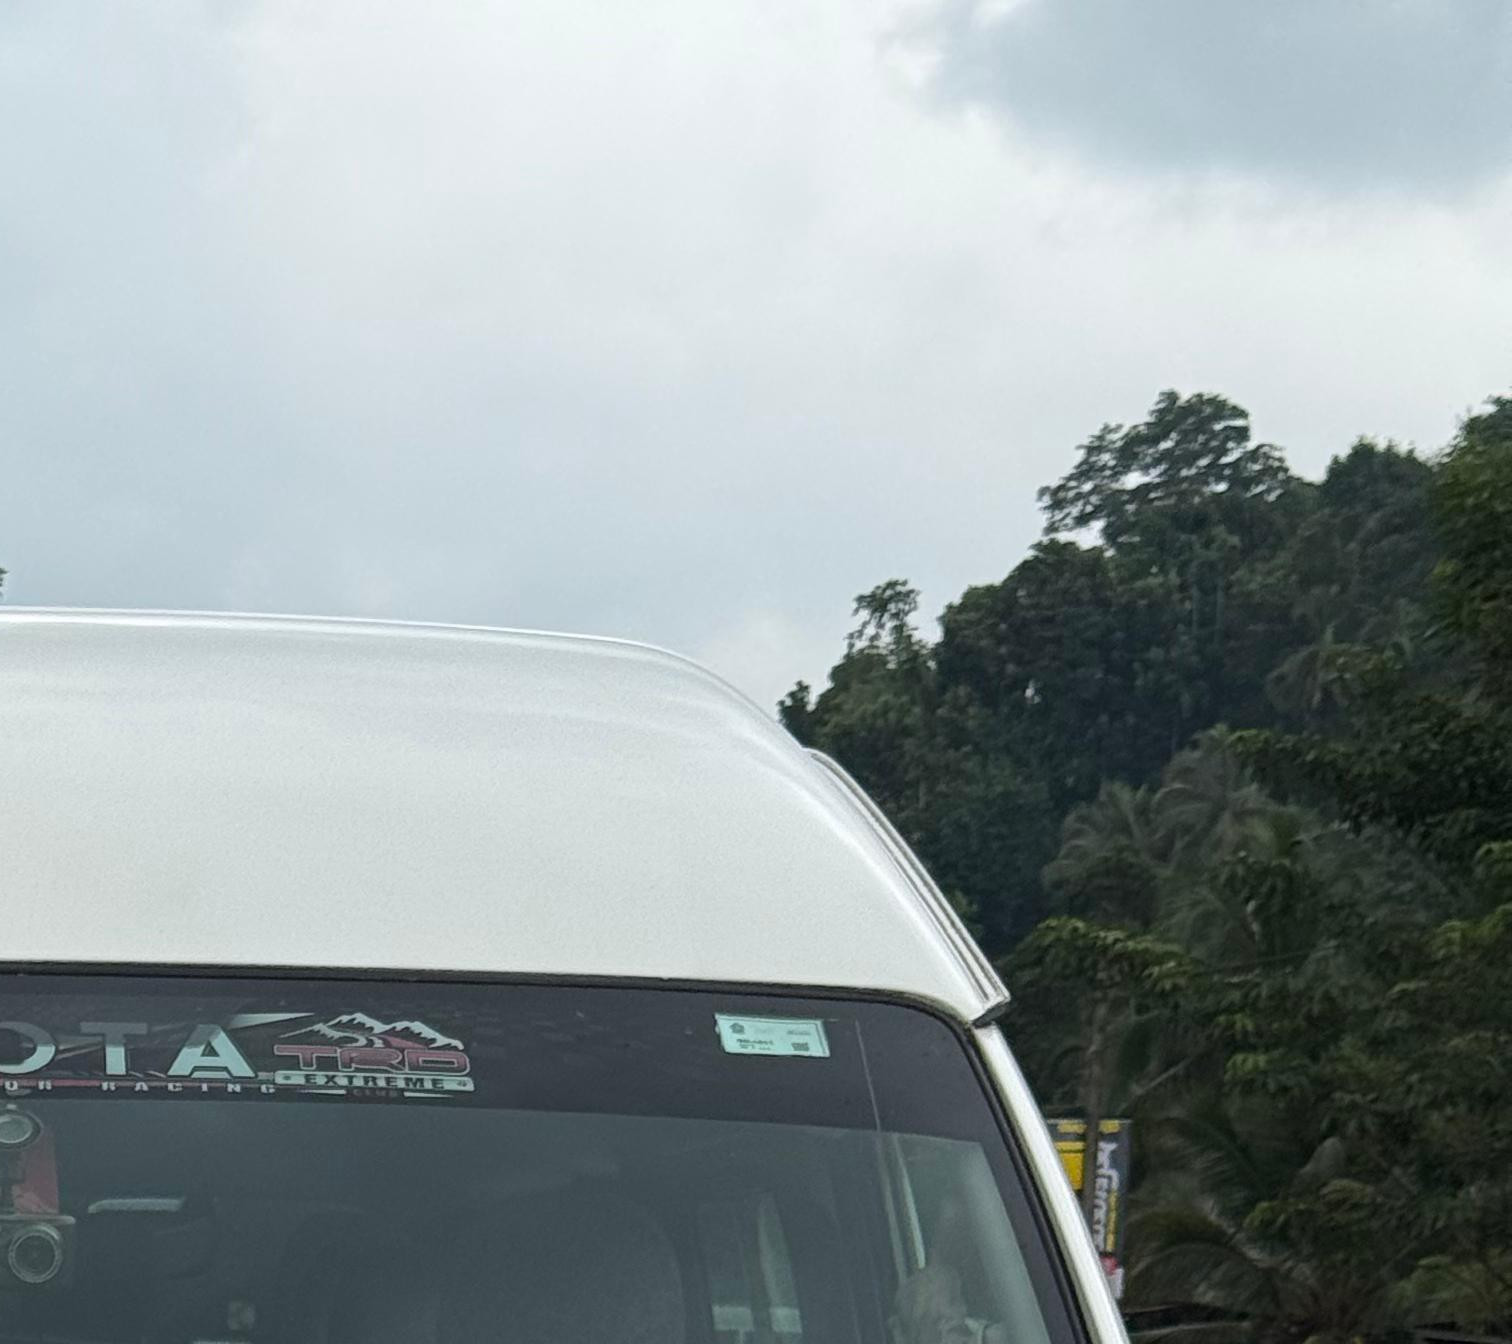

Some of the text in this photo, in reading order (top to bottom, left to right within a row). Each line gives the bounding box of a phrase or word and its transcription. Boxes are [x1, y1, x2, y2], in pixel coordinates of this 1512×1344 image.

[274, 1044, 471, 1075] TRD
[100, 1080, 277, 1093] RACING
[304, 1075, 445, 1089] EXTREME
